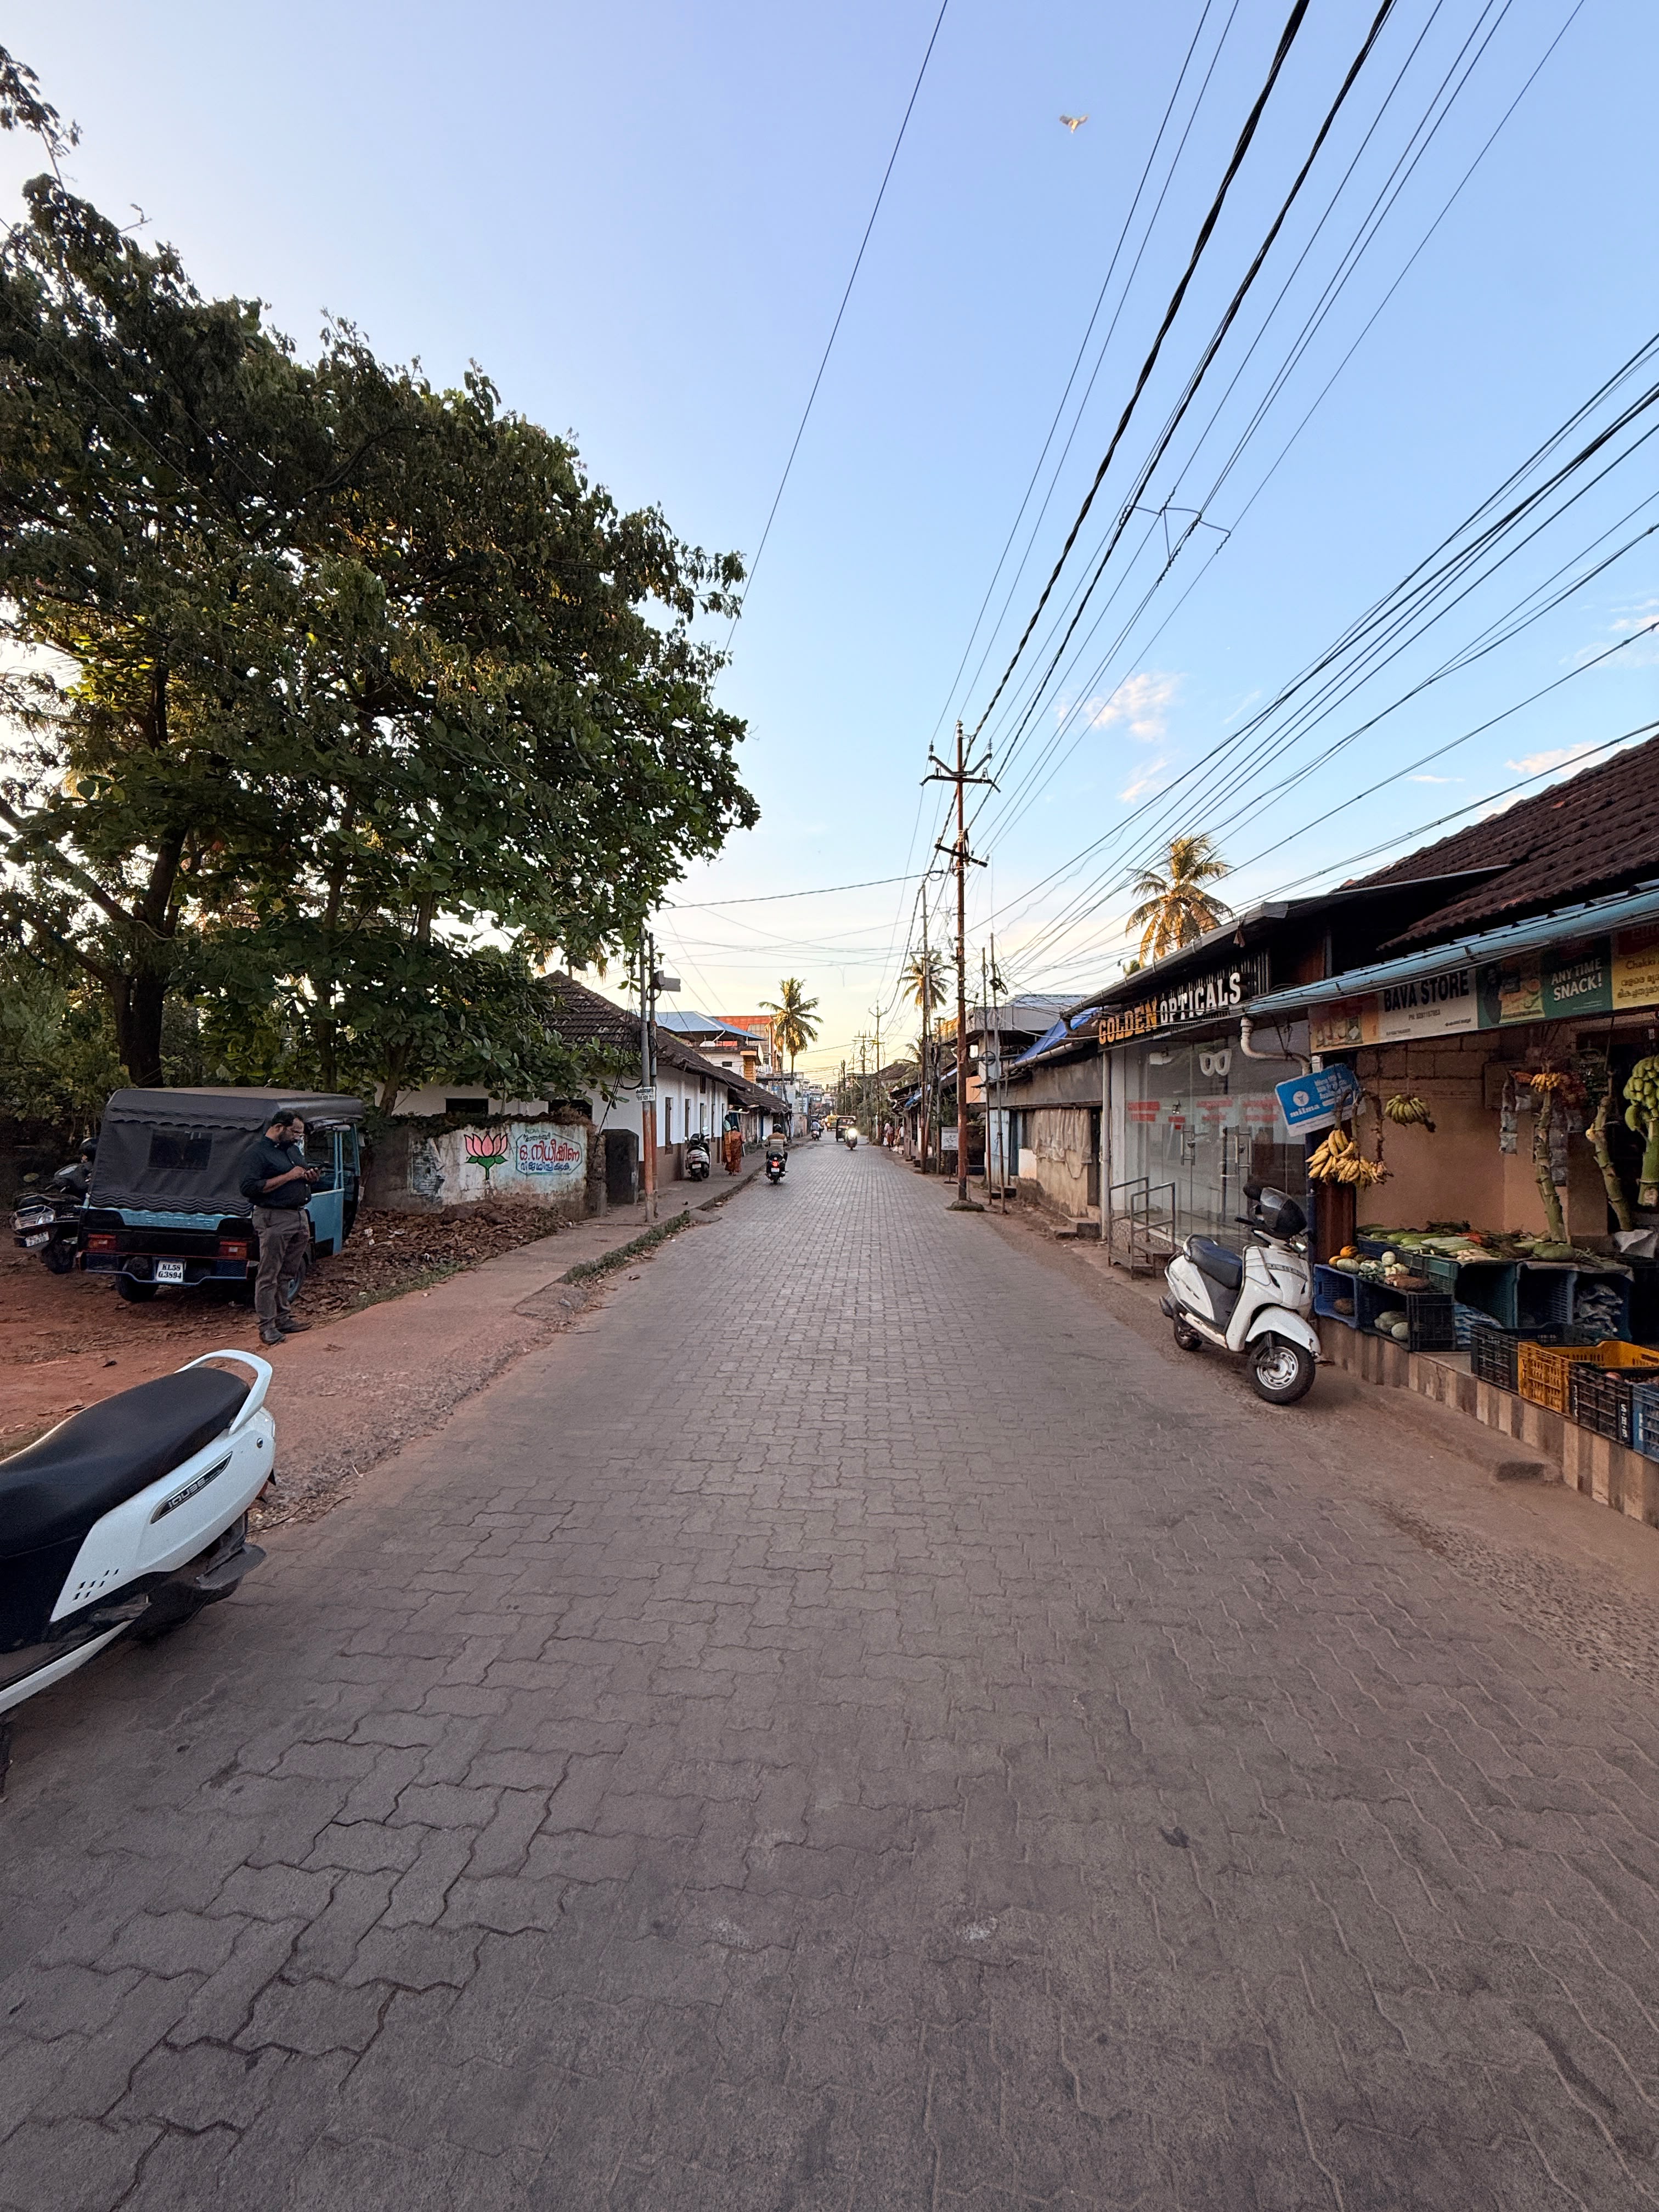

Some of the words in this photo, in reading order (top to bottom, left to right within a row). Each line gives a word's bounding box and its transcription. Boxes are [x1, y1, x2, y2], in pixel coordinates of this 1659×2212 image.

[1551, 968, 1573, 985] ANY
[1575, 958, 1602, 977] TIME
[1626, 958, 1655, 969] Chakki
[1384, 983, 1417, 1013] BAVA
[1421, 969, 1469, 1005] STORE
[1553, 972, 1603, 1002] SNACK!
[1098, 1000, 1158, 1045] GOLDEN
[1160, 972, 1241, 1024] OPTICALS
[1290, 1104, 1321, 1118] milma
